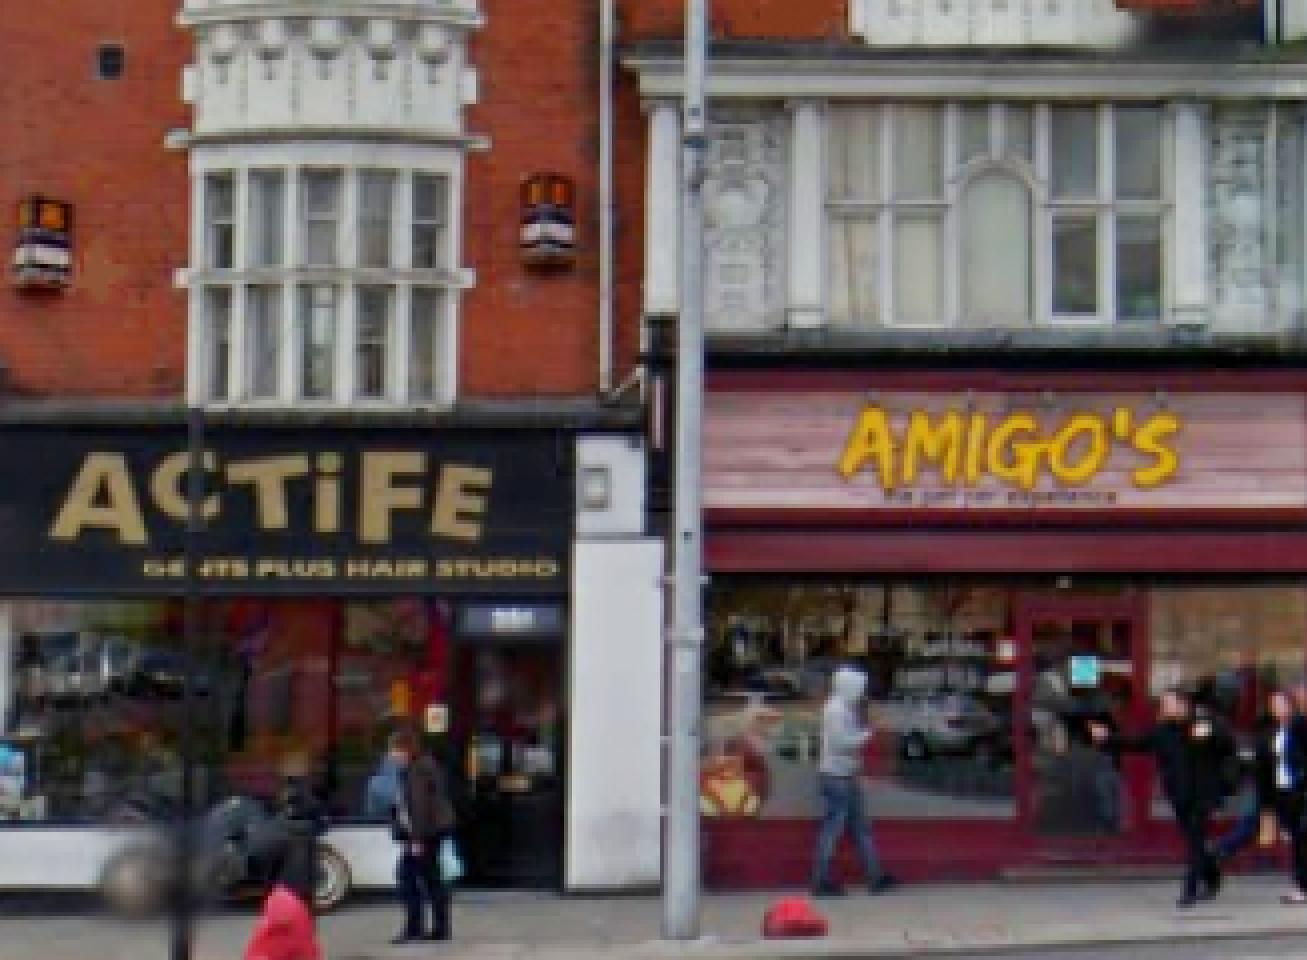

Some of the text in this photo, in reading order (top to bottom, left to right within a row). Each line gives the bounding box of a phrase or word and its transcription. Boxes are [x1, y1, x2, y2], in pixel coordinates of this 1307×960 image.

[839, 401, 1183, 490] AMIGO'S
[256, 558, 335, 578] PLUS
[347, 558, 428, 578] HAIR
[436, 558, 560, 578] STUDIO
